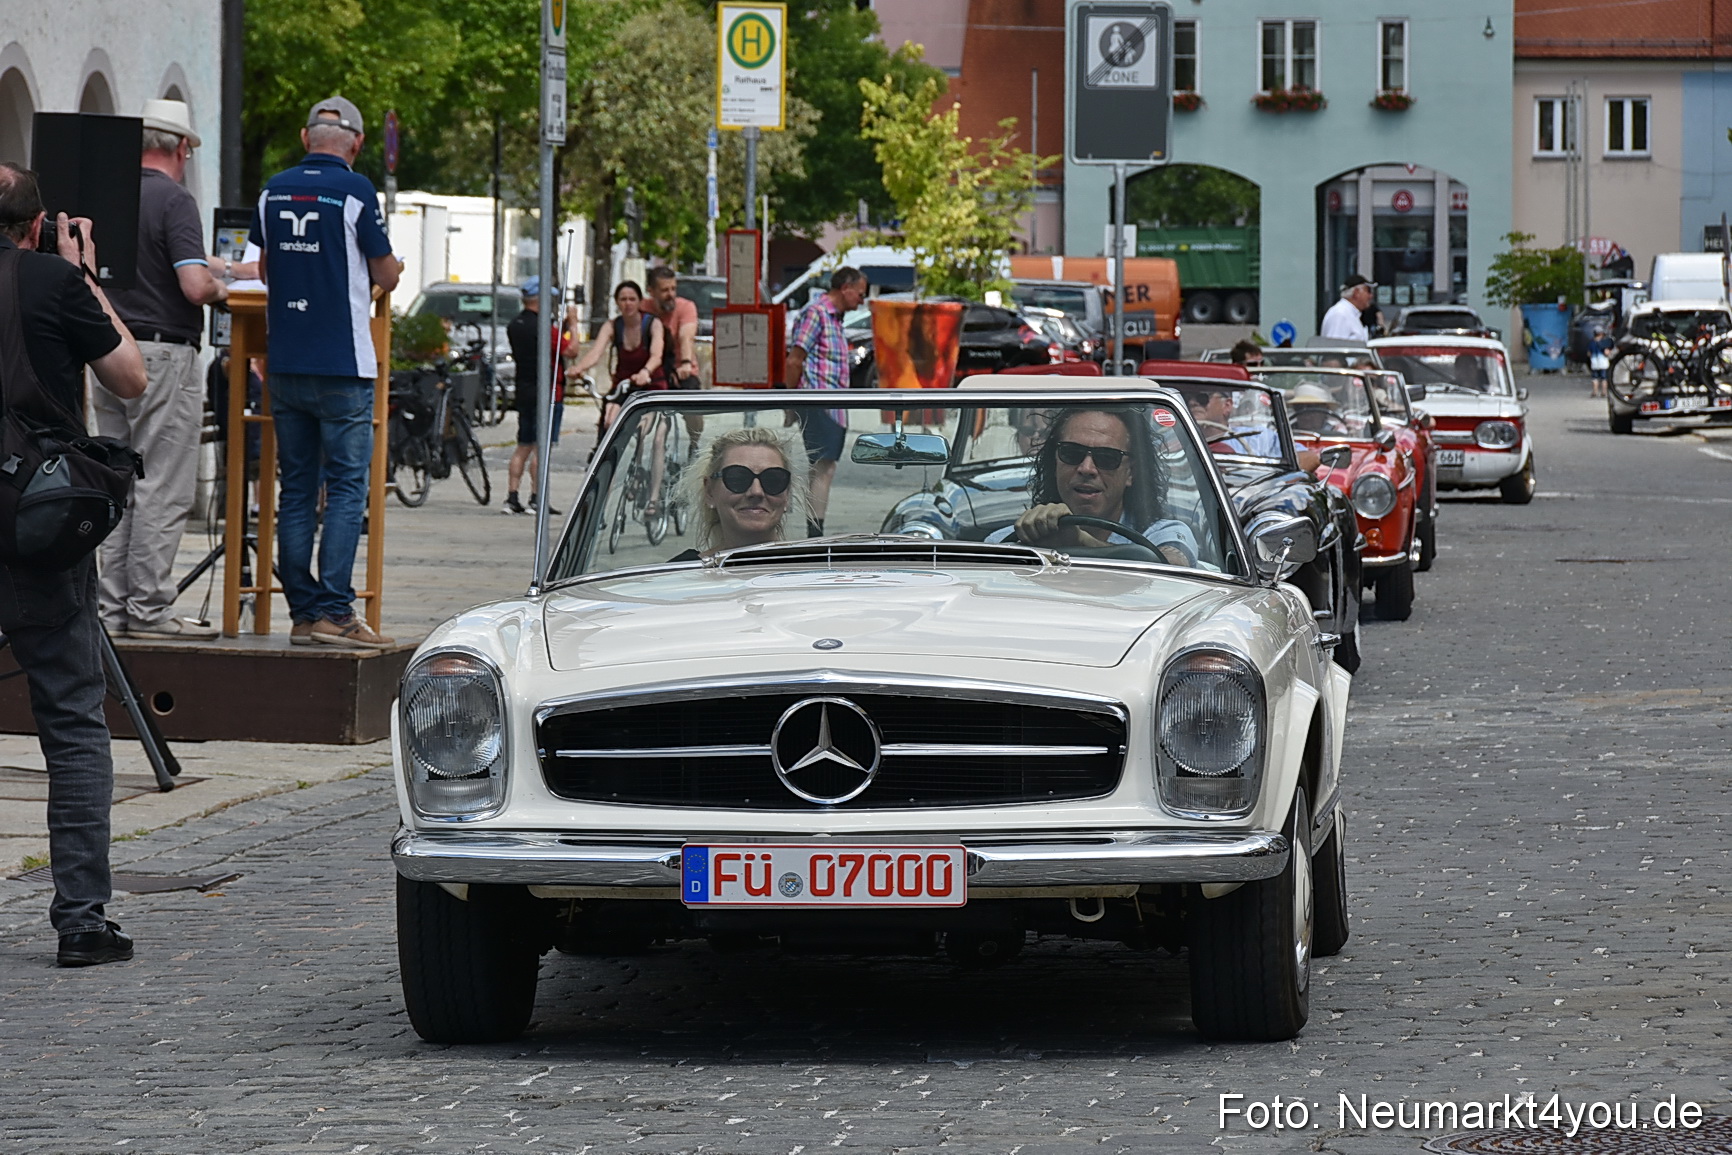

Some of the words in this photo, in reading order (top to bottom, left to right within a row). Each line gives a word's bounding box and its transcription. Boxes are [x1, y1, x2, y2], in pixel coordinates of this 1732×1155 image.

[742, 25, 761, 56] H
[734, 75, 767, 84] Rathaus
[1104, 71, 1139, 83] ZONE
[280, 241, 320, 253] randstad
[714, 853, 772, 897] FÜ
[809, 853, 953, 897] 07000
[691, 880, 701, 893] D
